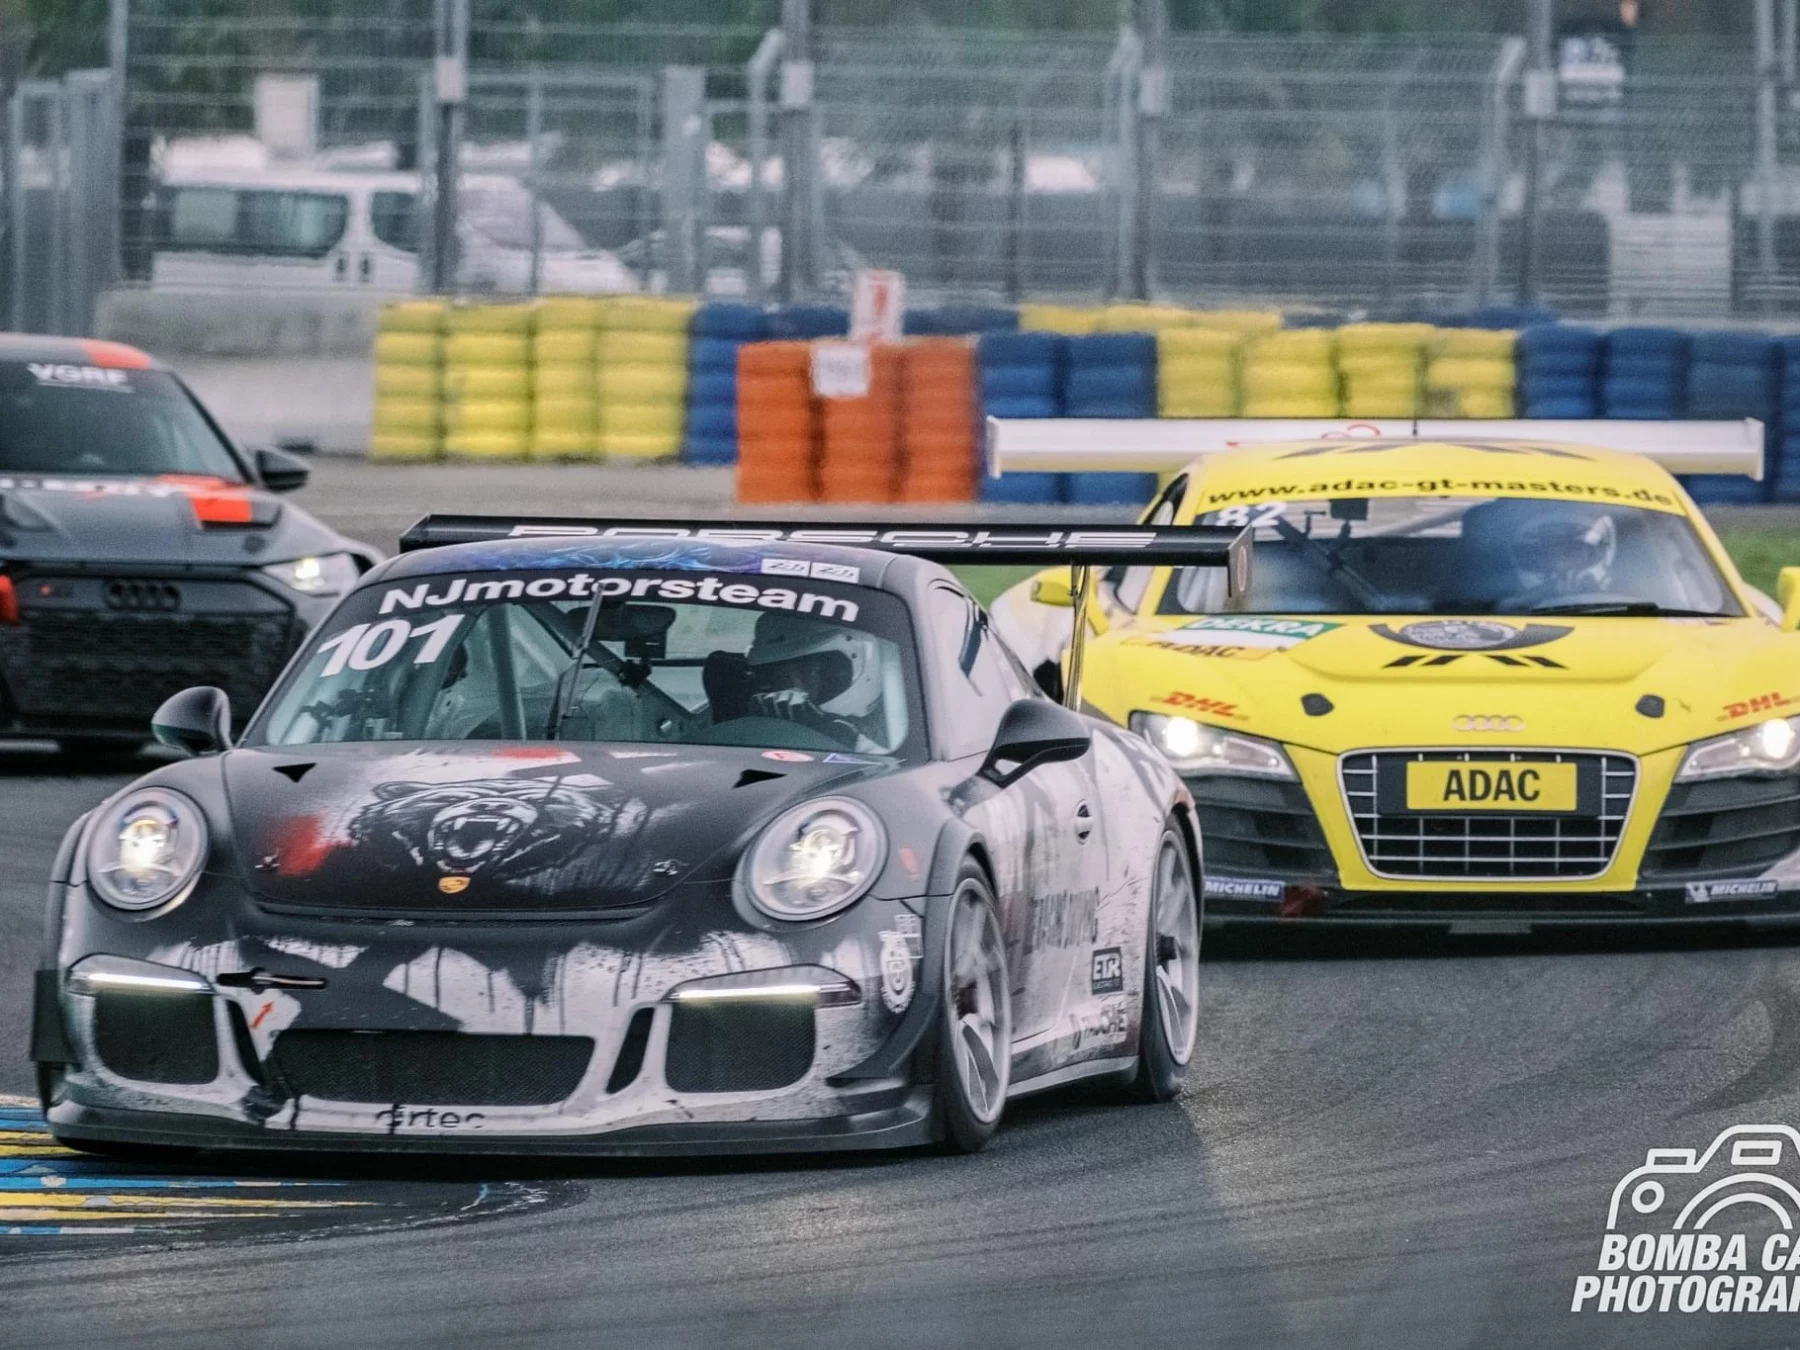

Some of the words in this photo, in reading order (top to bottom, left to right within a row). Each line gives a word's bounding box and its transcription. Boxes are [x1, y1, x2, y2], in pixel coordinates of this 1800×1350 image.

[1208, 480, 1673, 505] www.adac-gt-masters.de
[1216, 502, 1286, 526] 82
[378, 573, 859, 622] NJmotorsteam
[1187, 615, 1325, 636] DEKRA
[317, 614, 465, 677] 101
[1162, 691, 1239, 718] DHL
[1721, 692, 1791, 719] DHL
[1443, 769, 1541, 802] ADAC
[1204, 881, 1280, 896] MICHELIN
[1093, 955, 1121, 980] ETR
